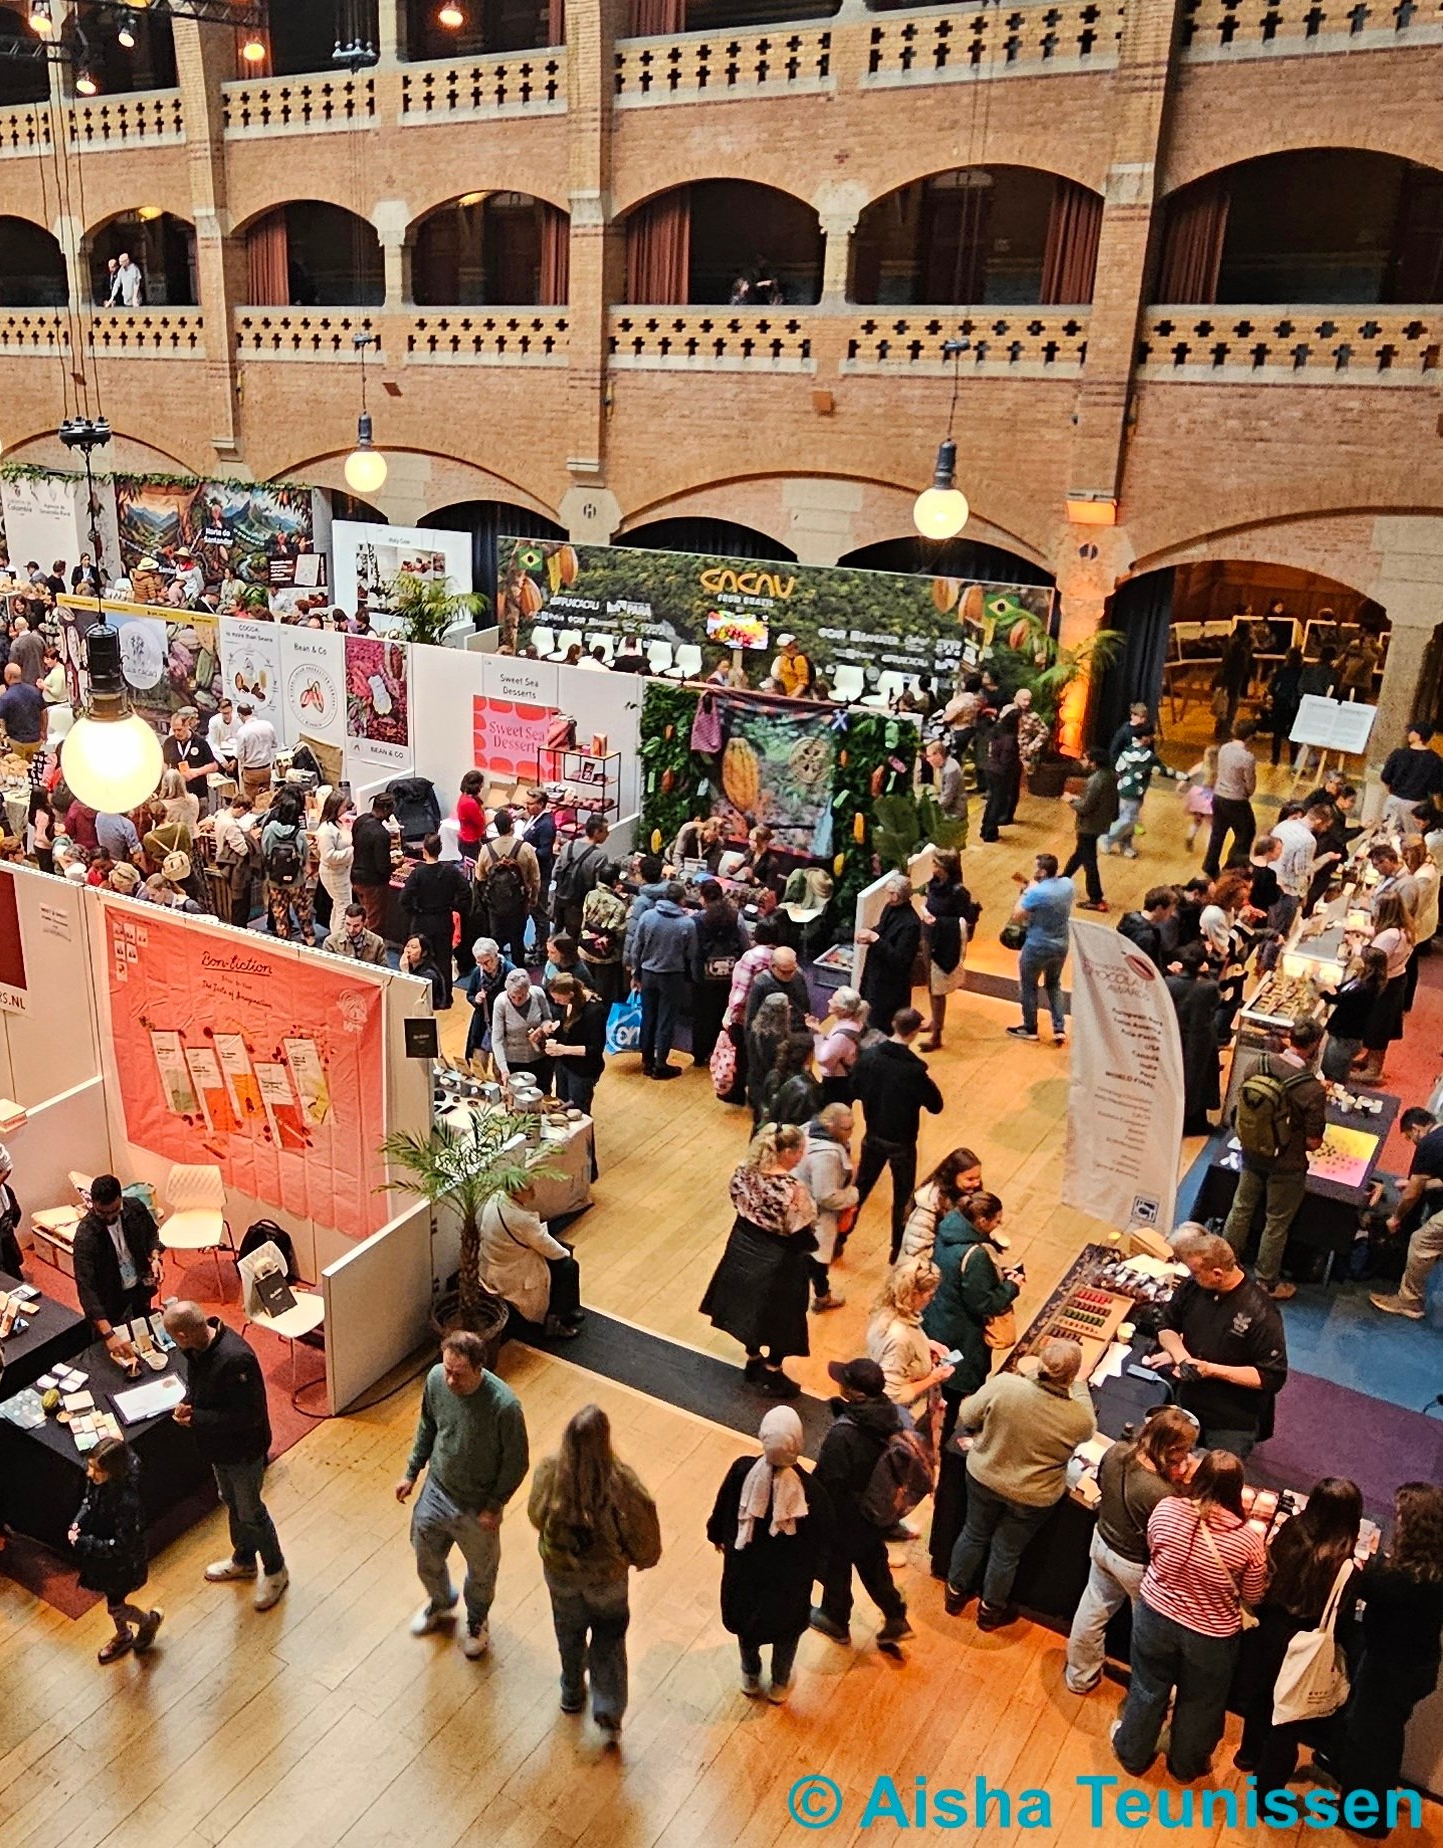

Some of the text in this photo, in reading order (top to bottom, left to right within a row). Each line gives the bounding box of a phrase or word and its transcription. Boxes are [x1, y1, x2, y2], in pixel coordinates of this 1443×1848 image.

[700, 568, 795, 599] CACAU
[294, 642, 309, 652] Bean
[318, 646, 327, 655] Co
[500, 673, 539, 688] Sweet Sea
[503, 686, 537, 699] Desserts
[489, 721, 545, 742] Sweet Sea
[493, 735, 536, 754] Dessert
[370, 746, 387, 755] BEAN
[394, 751, 404, 759] CO
